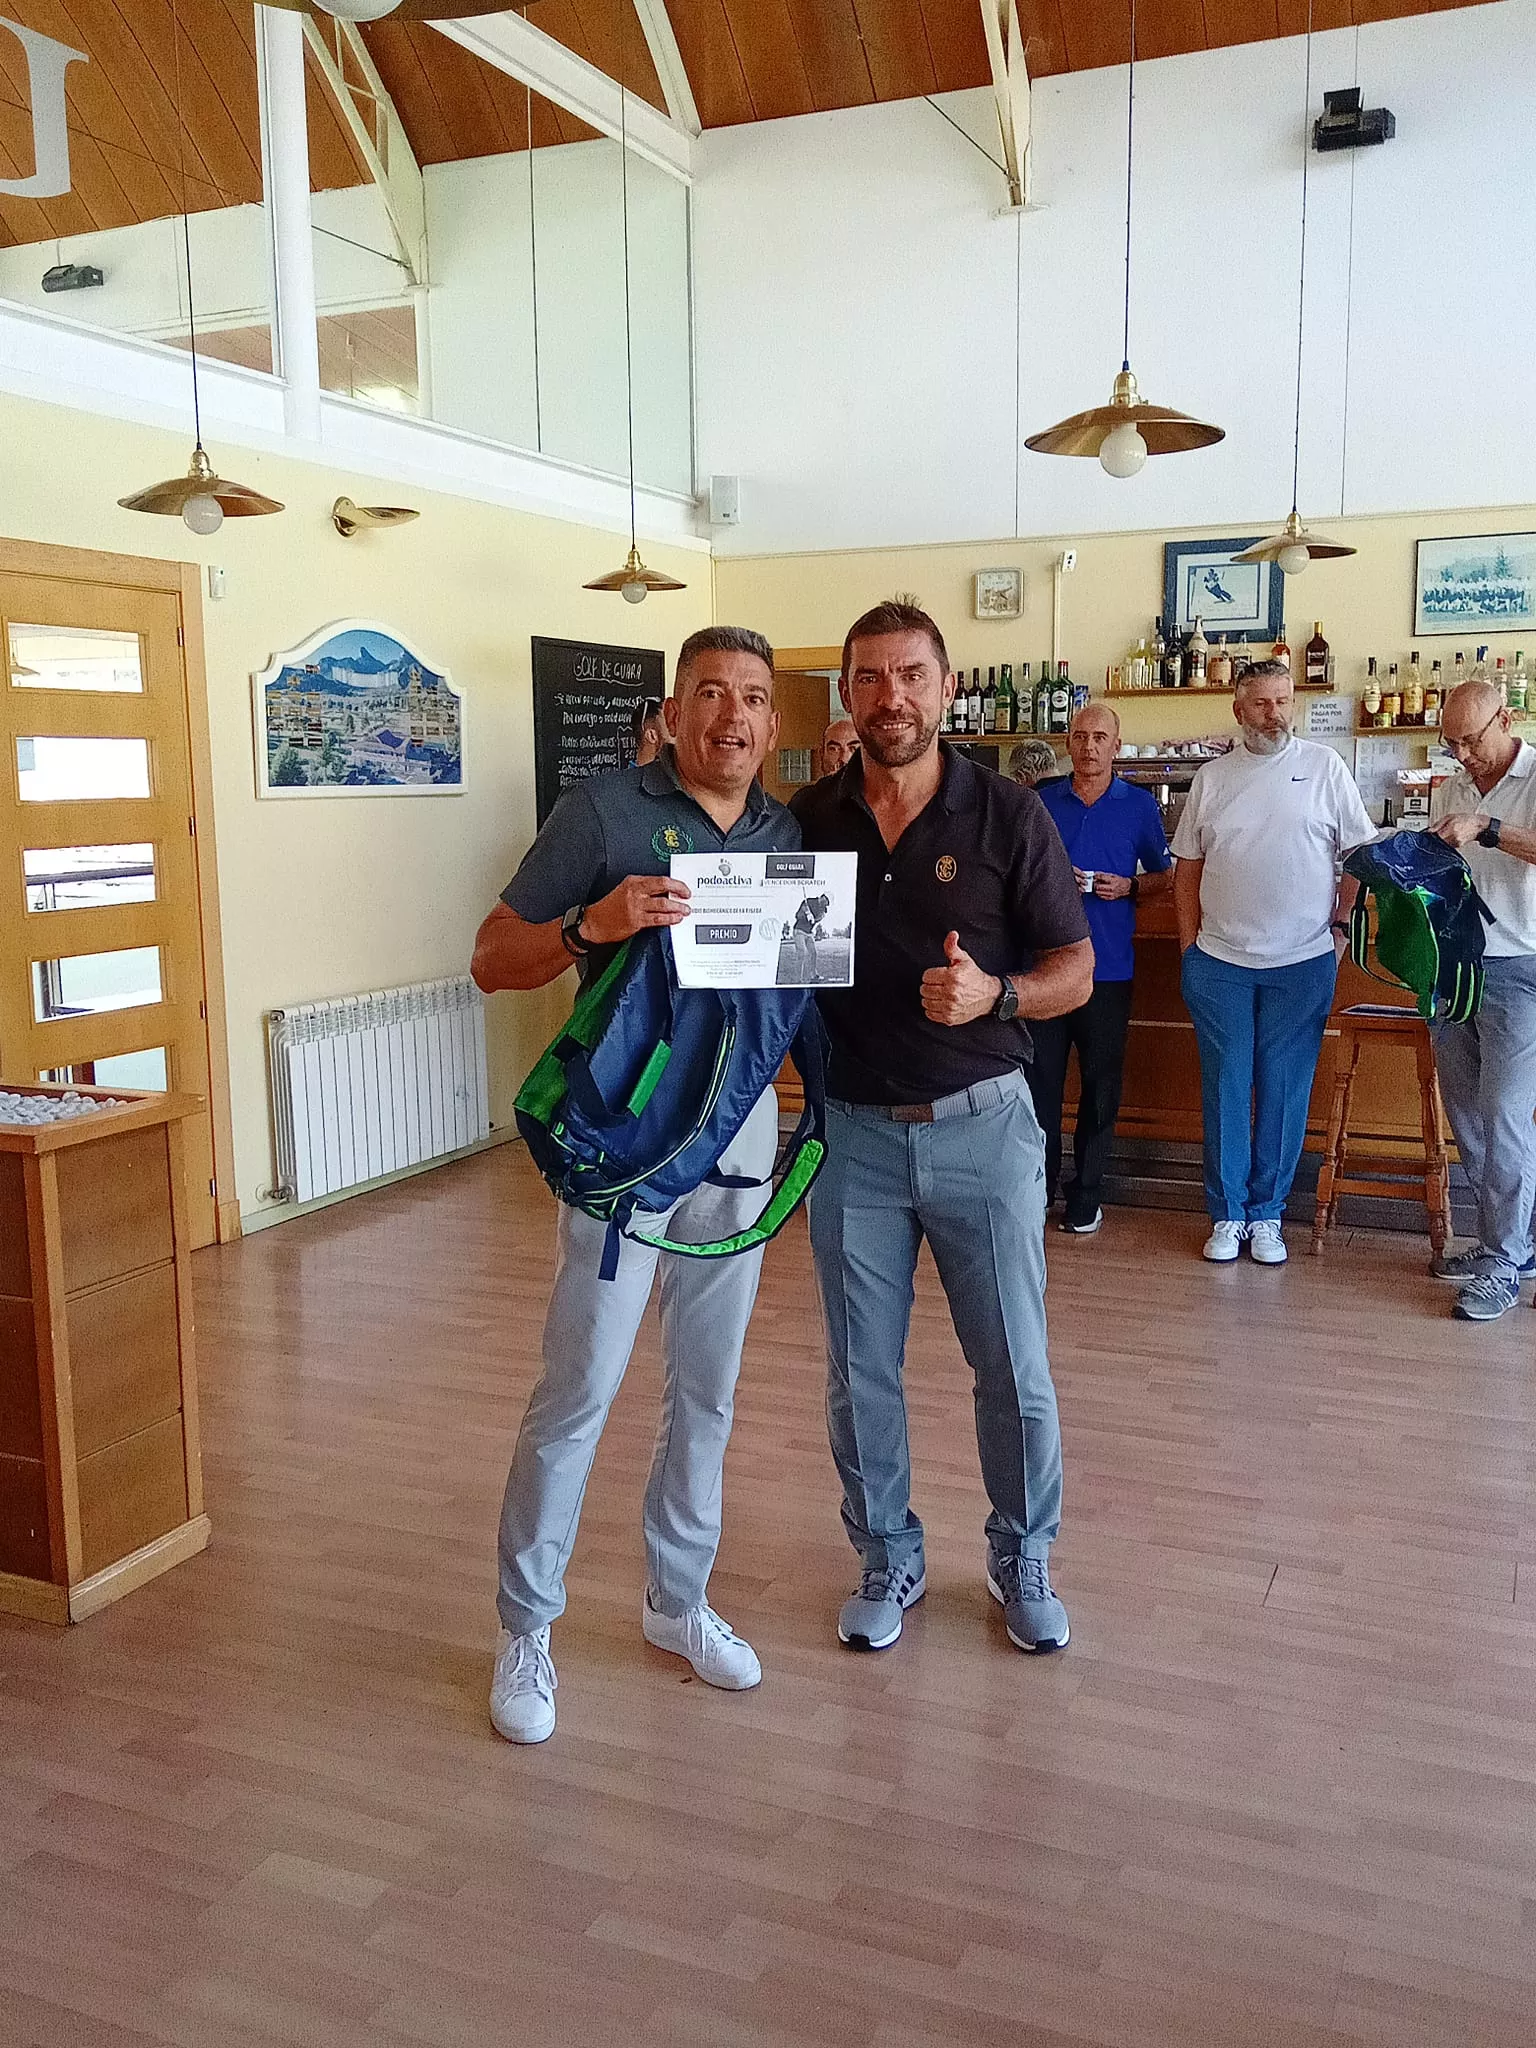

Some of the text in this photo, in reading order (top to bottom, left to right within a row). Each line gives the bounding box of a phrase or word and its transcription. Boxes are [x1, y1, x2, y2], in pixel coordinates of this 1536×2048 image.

[601, 660, 612, 678] DE
[613, 662, 642, 680] GUARA
[697, 874, 752, 889] podoactiva
[797, 879, 826, 887] SCRATCH
[710, 928, 738, 940] PREMIO
